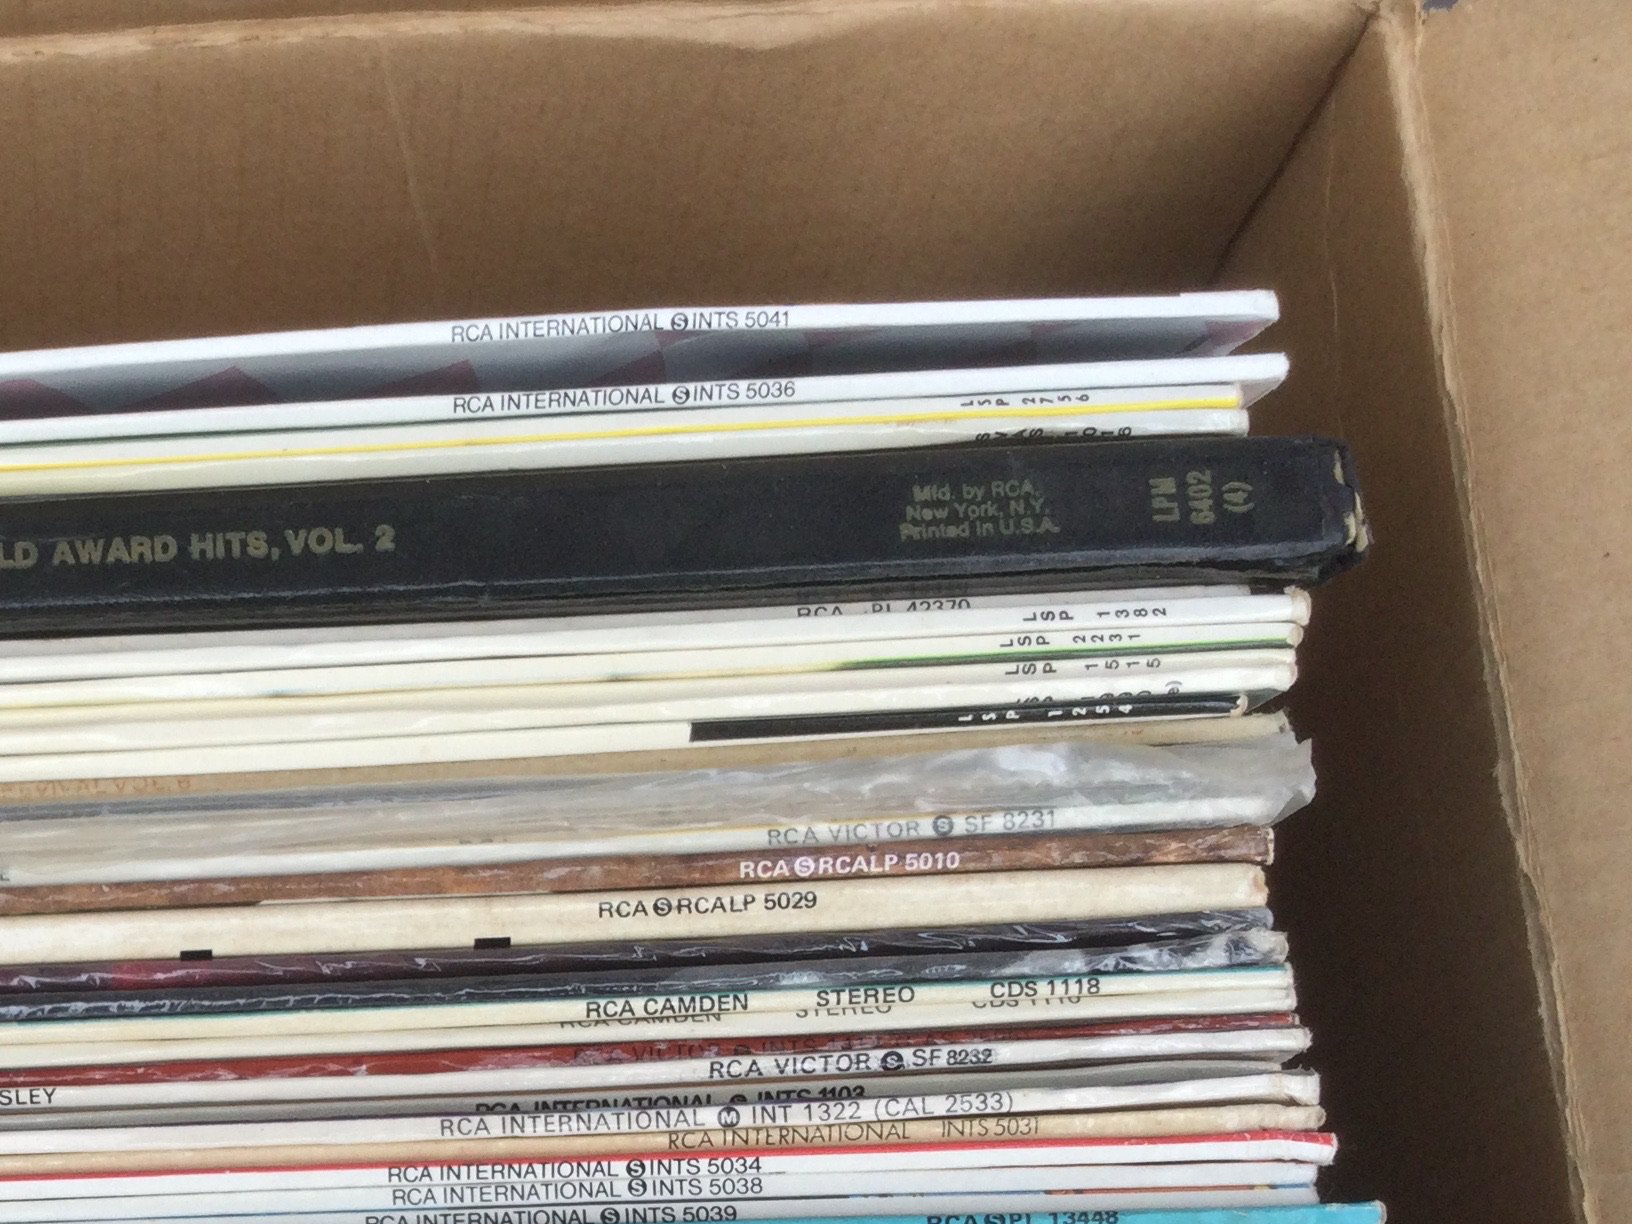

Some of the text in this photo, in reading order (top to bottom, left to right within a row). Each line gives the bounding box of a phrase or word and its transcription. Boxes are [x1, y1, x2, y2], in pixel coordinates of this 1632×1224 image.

[451, 311, 790, 343] RCA INTERNATIONAL 5041
[454, 381, 795, 414] RCA INTERNATIONAL 5036
[53, 535, 178, 566] AWARD
[189, 529, 280, 561] HITS,
[375, 524, 396, 551] 2
[906, 851, 960, 871] 5010
[764, 889, 818, 911] 5029
[586, 977, 1100, 1019] RCA CAMDEN STEREO CDS 1118
[709, 1052, 871, 1080] RCA VICTOR
[441, 1101, 861, 1137] RCA INTERNATIONAL INT 1322
[388, 1157, 761, 1183] RCA INTERNATIONAL 5034
